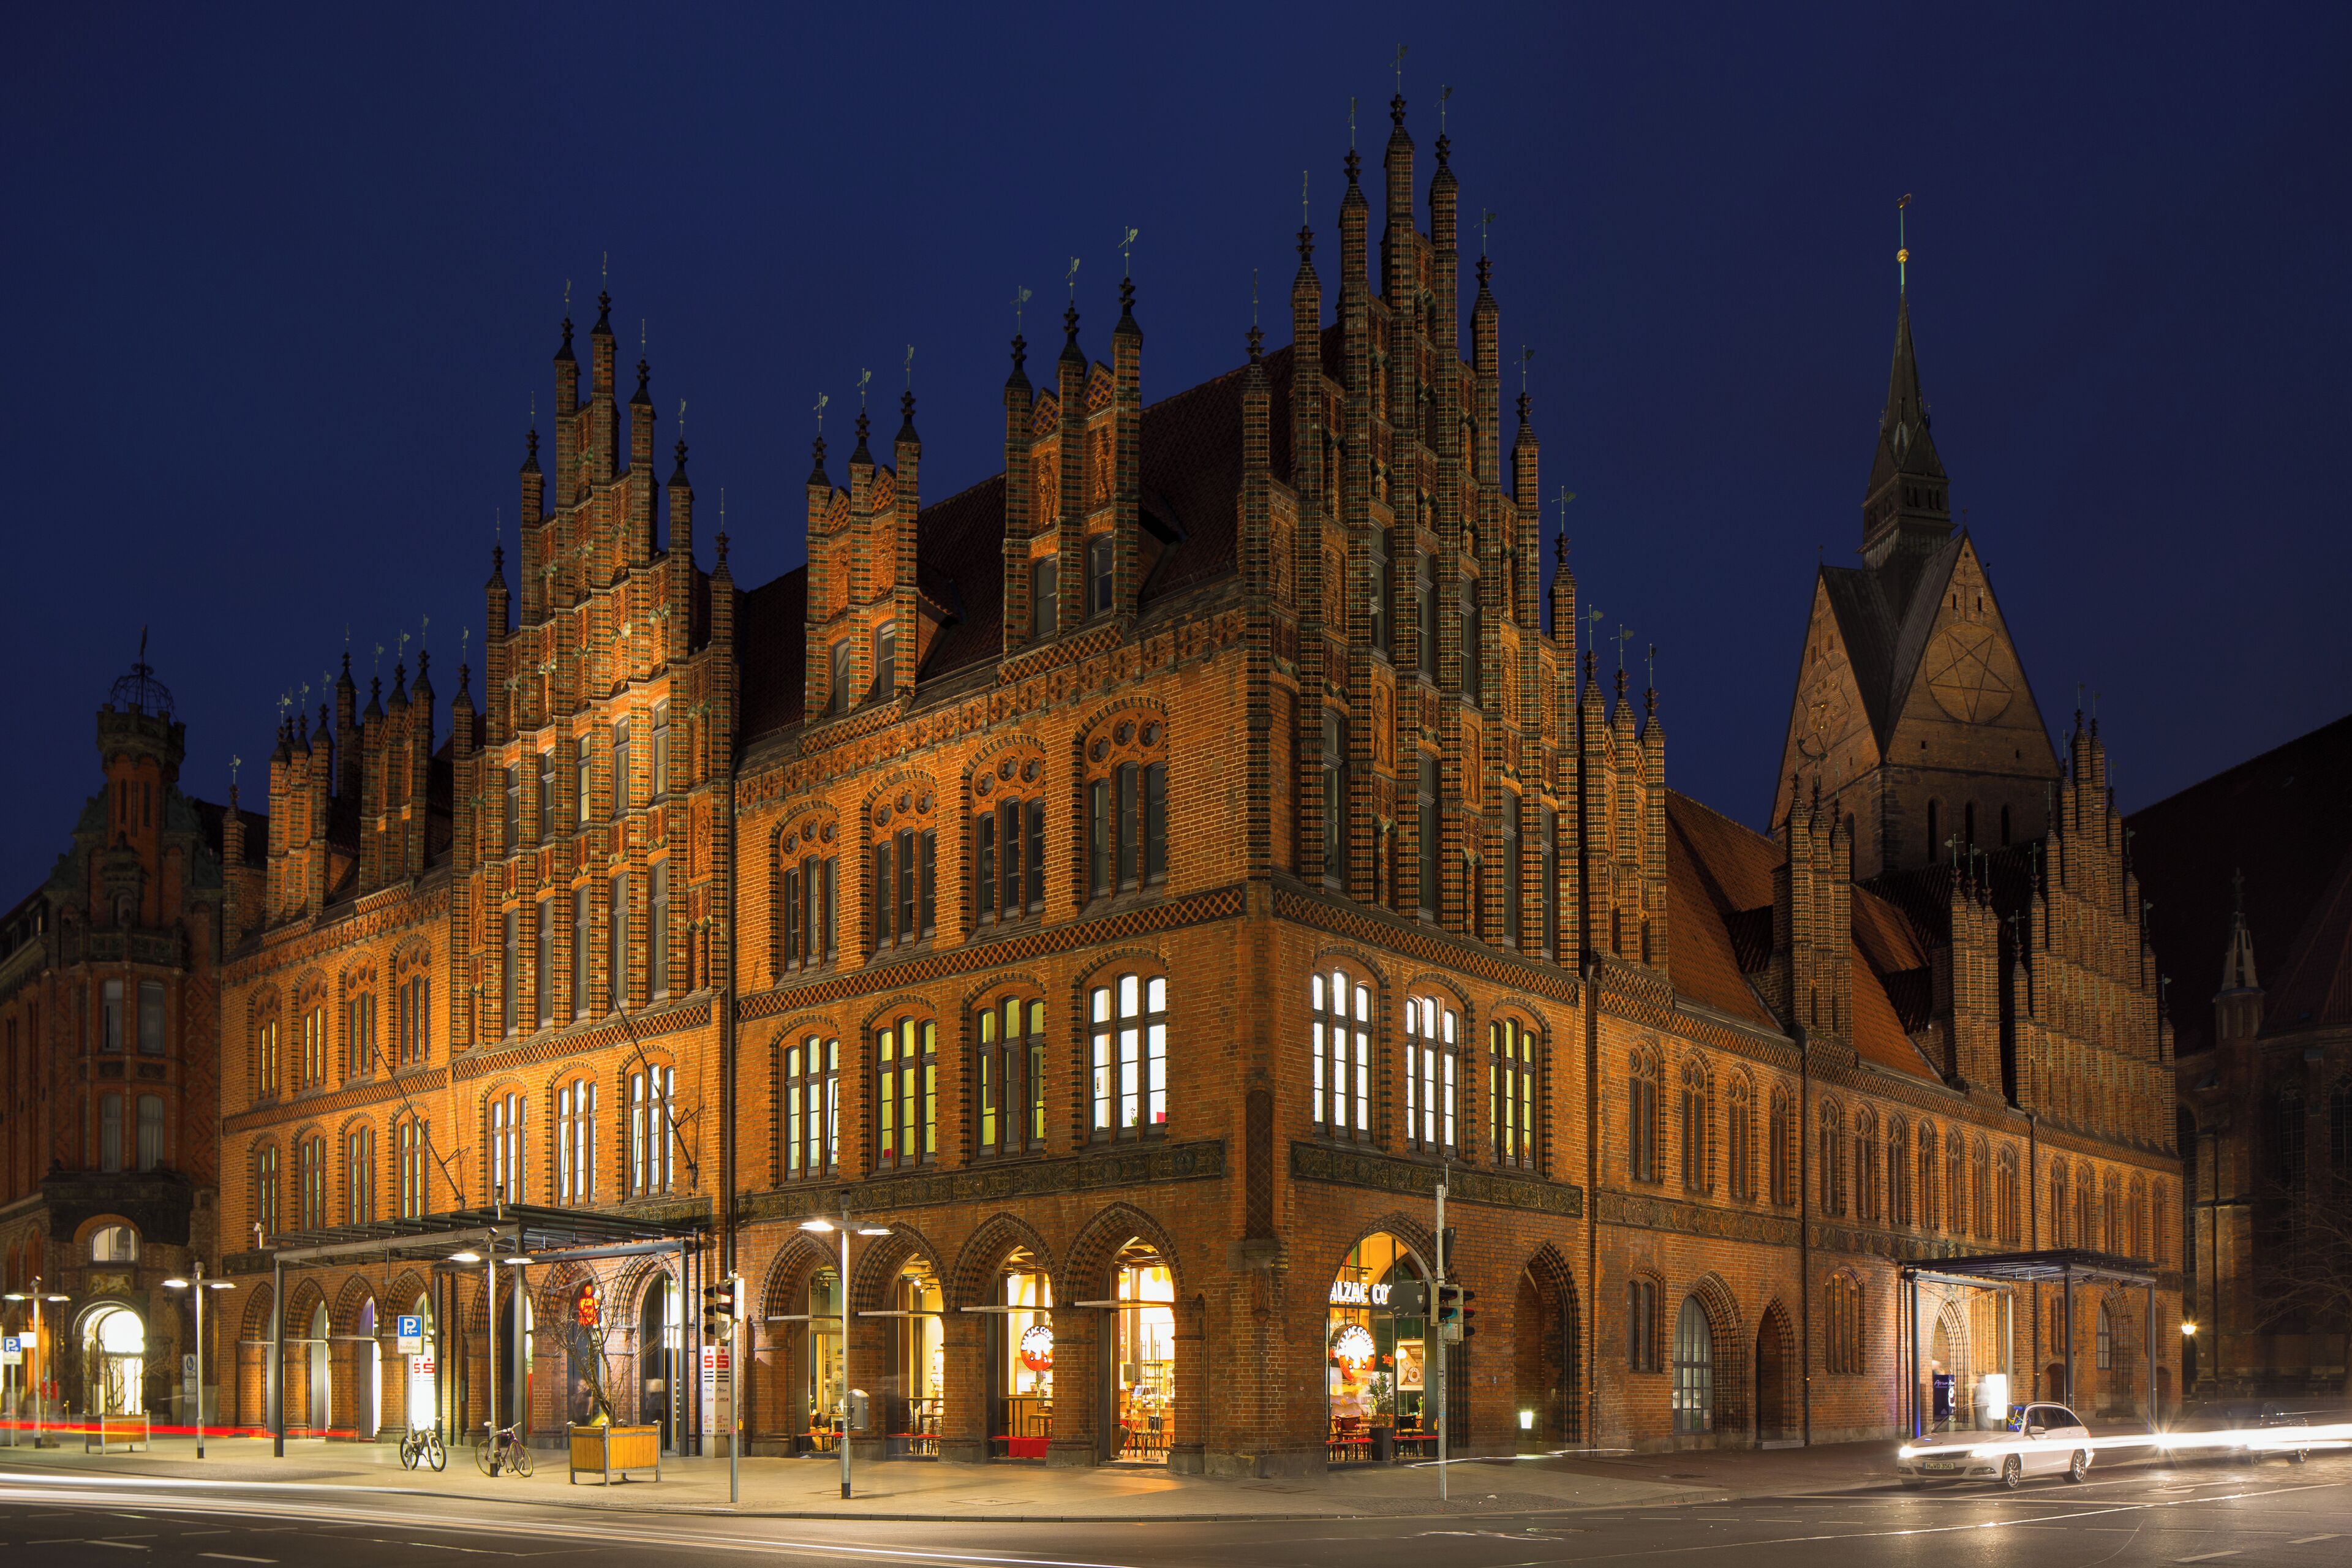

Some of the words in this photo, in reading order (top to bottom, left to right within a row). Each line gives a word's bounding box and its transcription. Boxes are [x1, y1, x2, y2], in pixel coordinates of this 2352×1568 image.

[1373, 1283, 1393, 1305] CO
[404, 1318, 417, 1335] P
[6, 1338, 17, 1351] P
